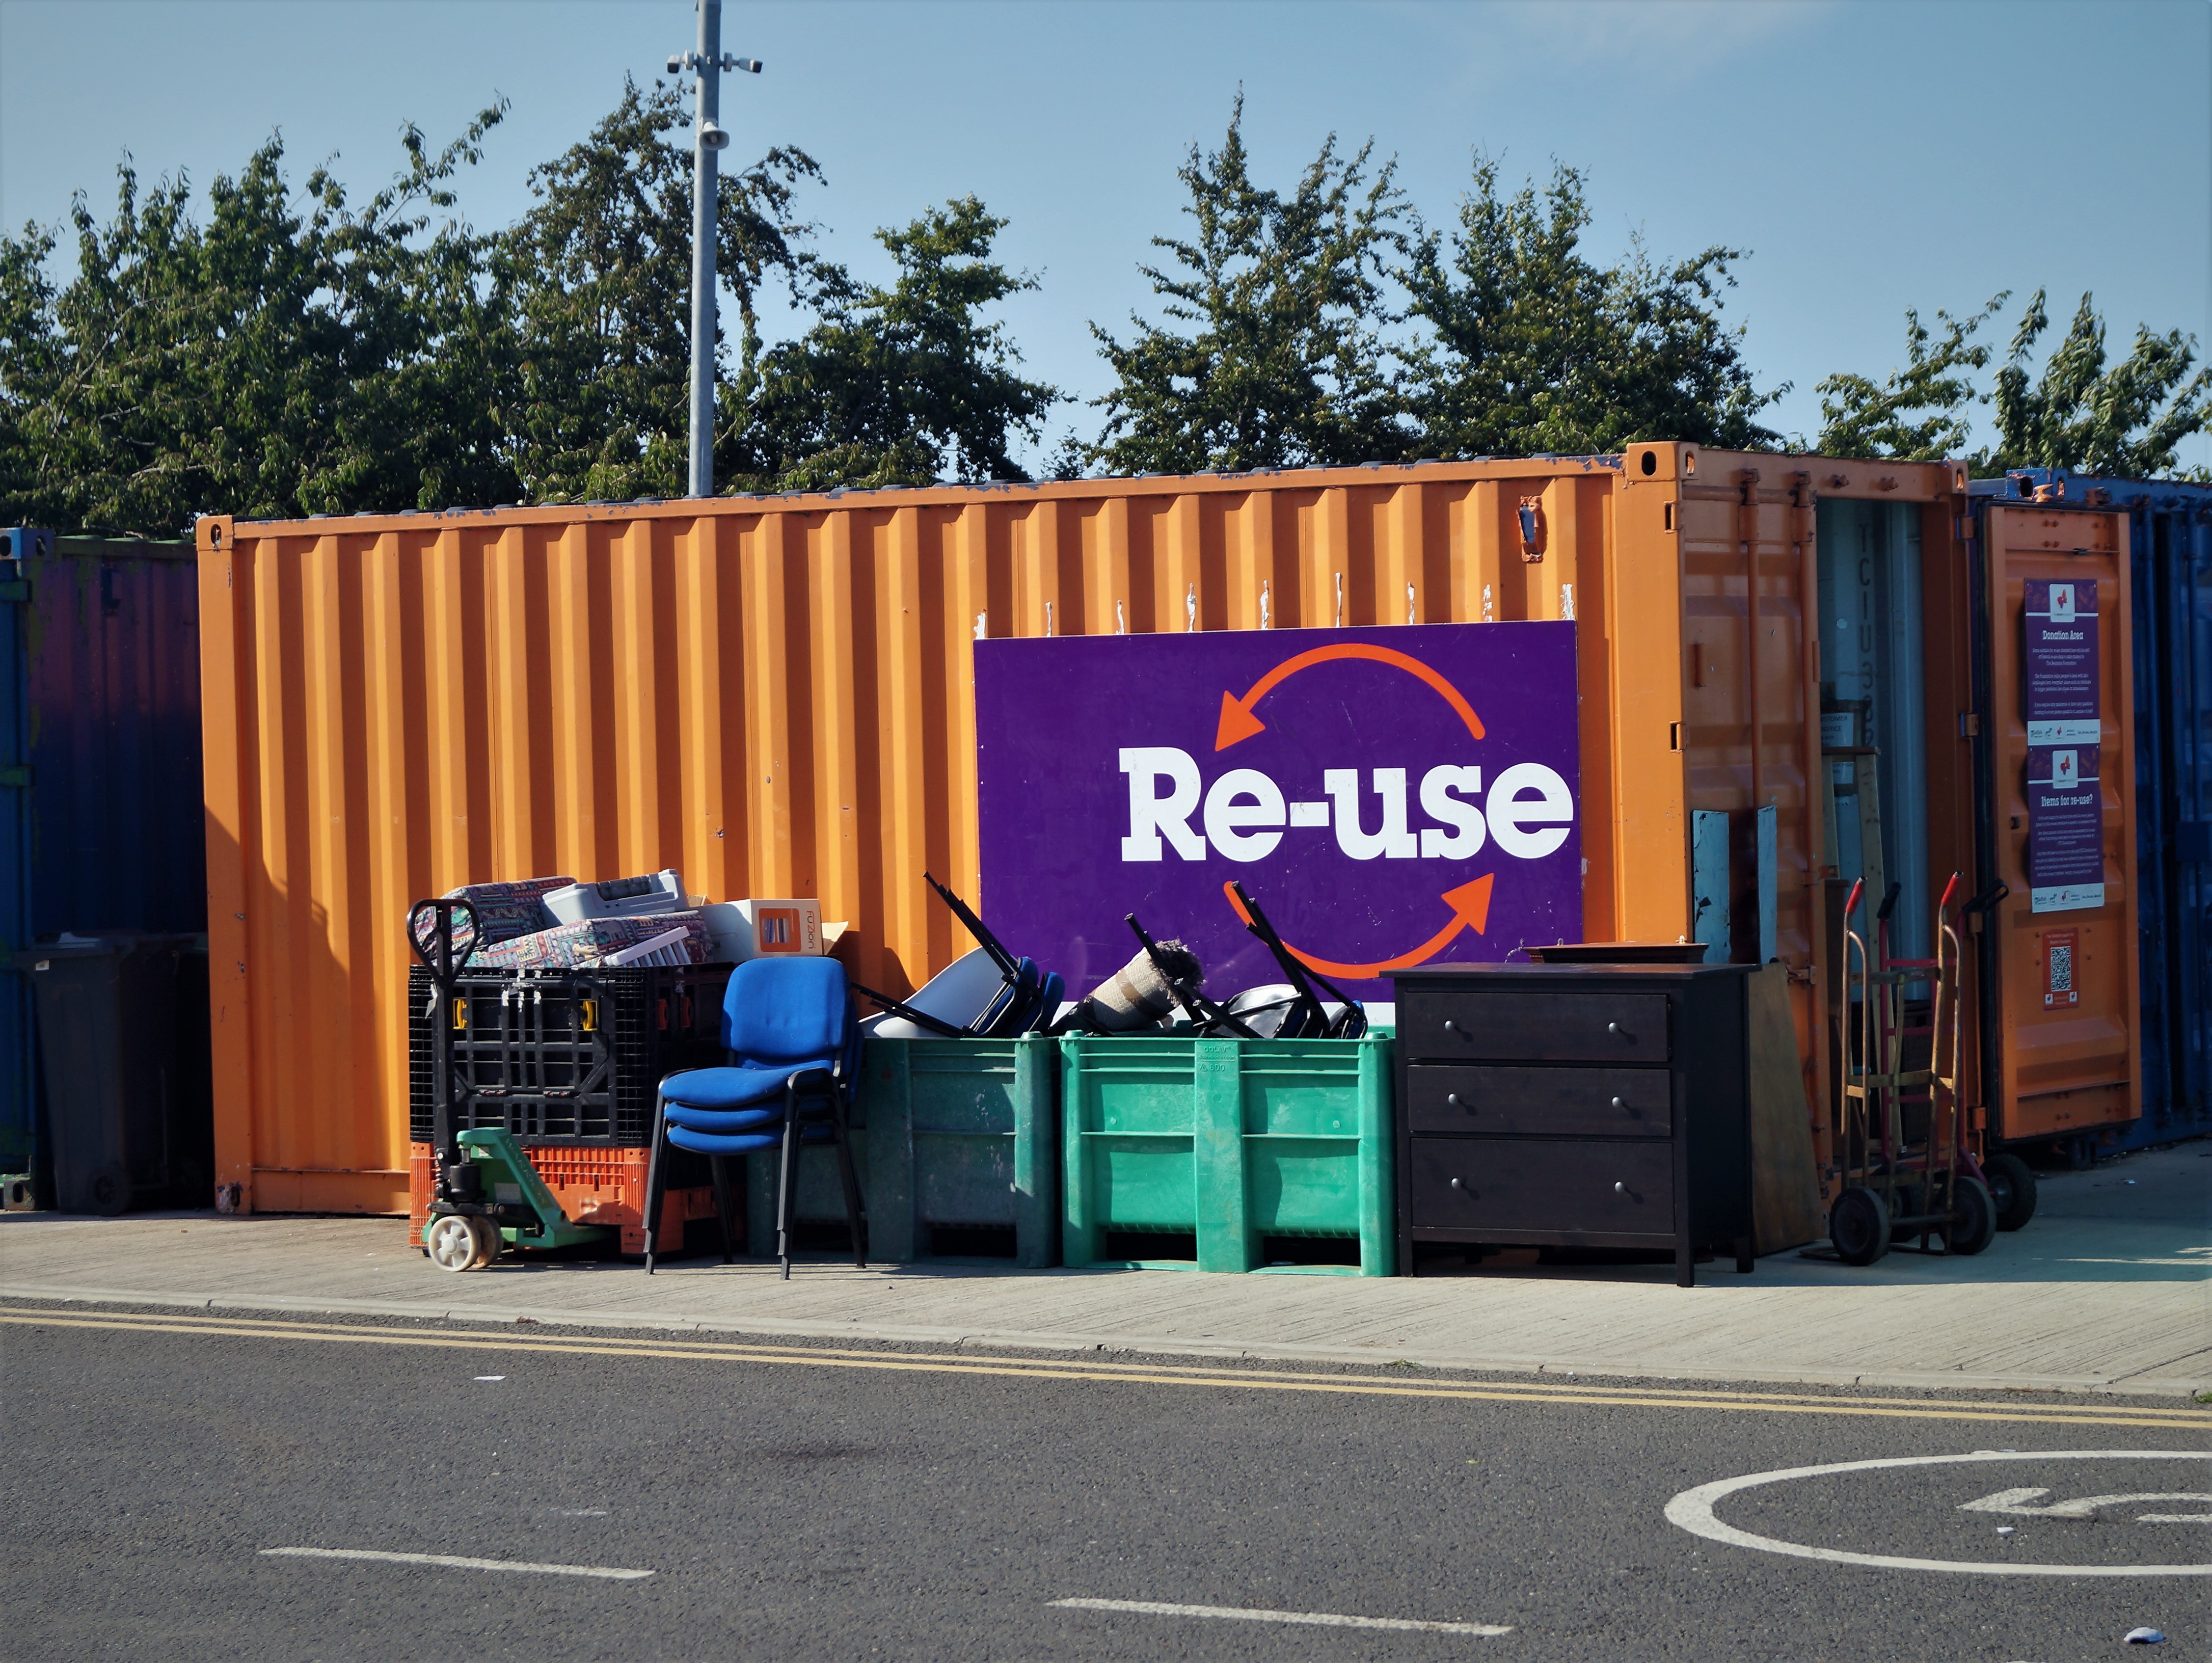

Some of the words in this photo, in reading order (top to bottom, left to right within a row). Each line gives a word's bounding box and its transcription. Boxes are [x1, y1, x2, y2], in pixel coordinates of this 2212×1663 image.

[1858, 522, 1872, 654] TCIU
[2042, 630, 2069, 640] Donation
[2070, 630, 2084, 640] Area
[1119, 746, 1574, 863] Re-use
[2041, 795, 2059, 807] Items
[2060, 795, 2070, 806] for
[2071, 793, 2093, 805] re-use?
